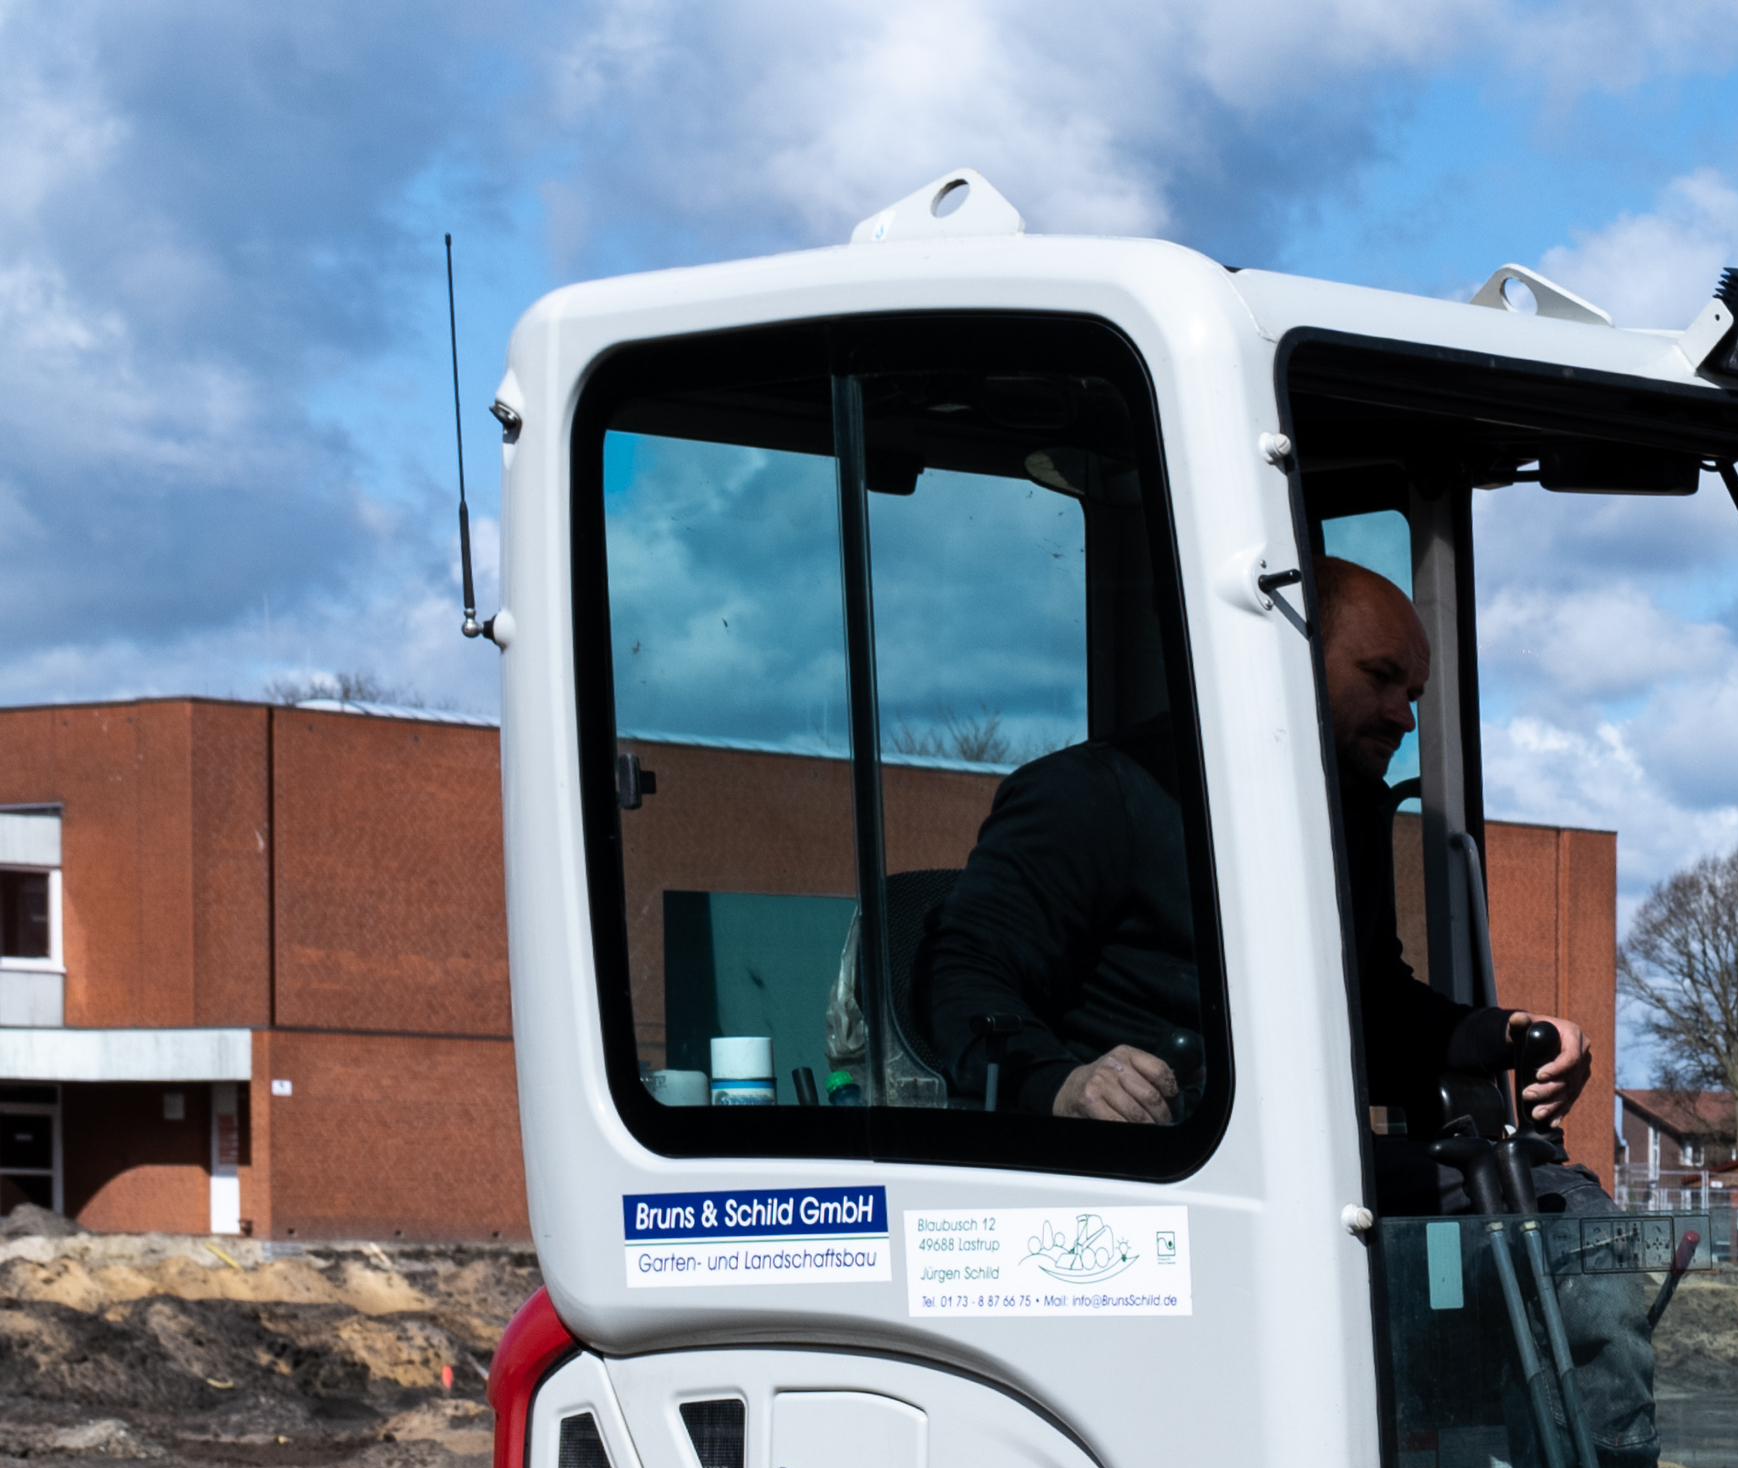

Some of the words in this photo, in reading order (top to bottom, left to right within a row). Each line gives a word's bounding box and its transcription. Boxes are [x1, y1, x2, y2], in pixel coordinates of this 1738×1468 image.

[635, 1203, 695, 1230] Bruns
[701, 1199, 718, 1228] &
[725, 1197, 794, 1227] Schild
[799, 1195, 874, 1225] GmbH
[917, 1218, 978, 1232] Blaubusch
[982, 1217, 996, 1231] 12
[958, 1237, 1000, 1255] Lastrup
[638, 1253, 702, 1273] Garten-
[707, 1251, 739, 1271] und
[744, 1248, 877, 1270] Landschaftsbau
[920, 1266, 960, 1284] Jürgen
[964, 1266, 1000, 1280] Schild
